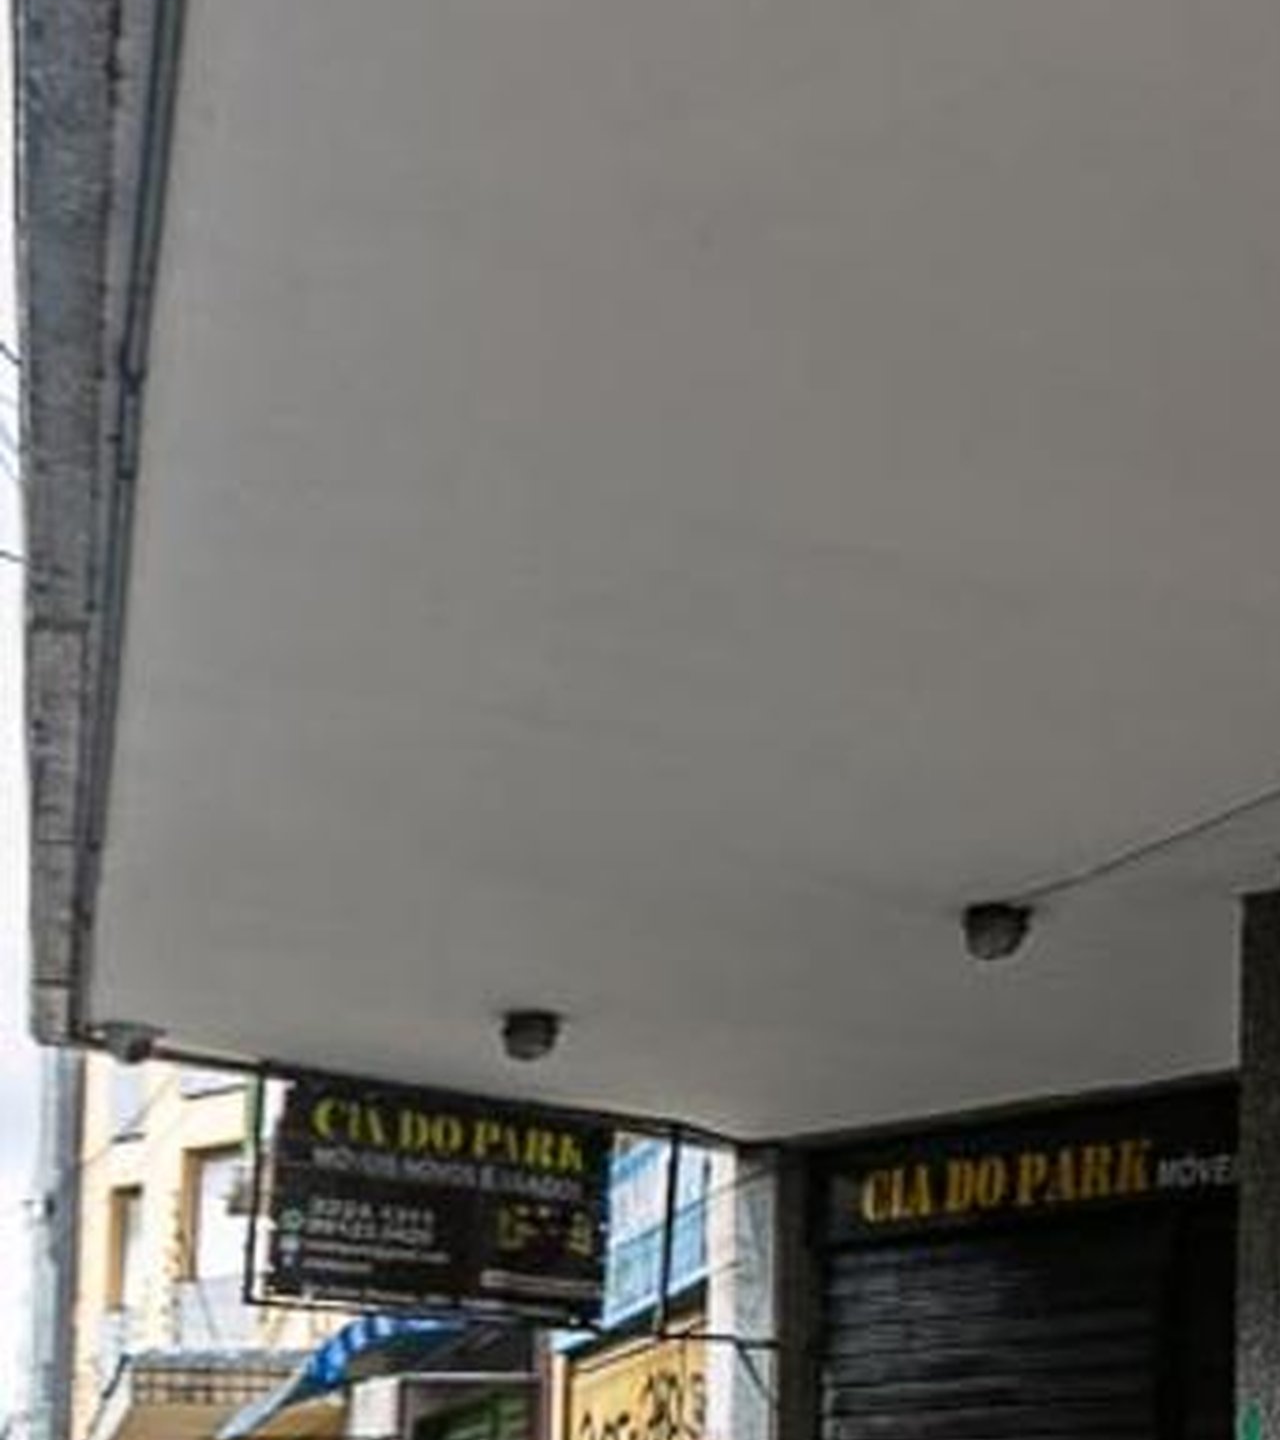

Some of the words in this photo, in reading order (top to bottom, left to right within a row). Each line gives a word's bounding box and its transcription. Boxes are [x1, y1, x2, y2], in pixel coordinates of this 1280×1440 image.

[399, 1109, 464, 1153] DO
[859, 1161, 932, 1224] CIA
[944, 1155, 1007, 1213] DO
[1016, 1139, 1153, 1207] PARK
